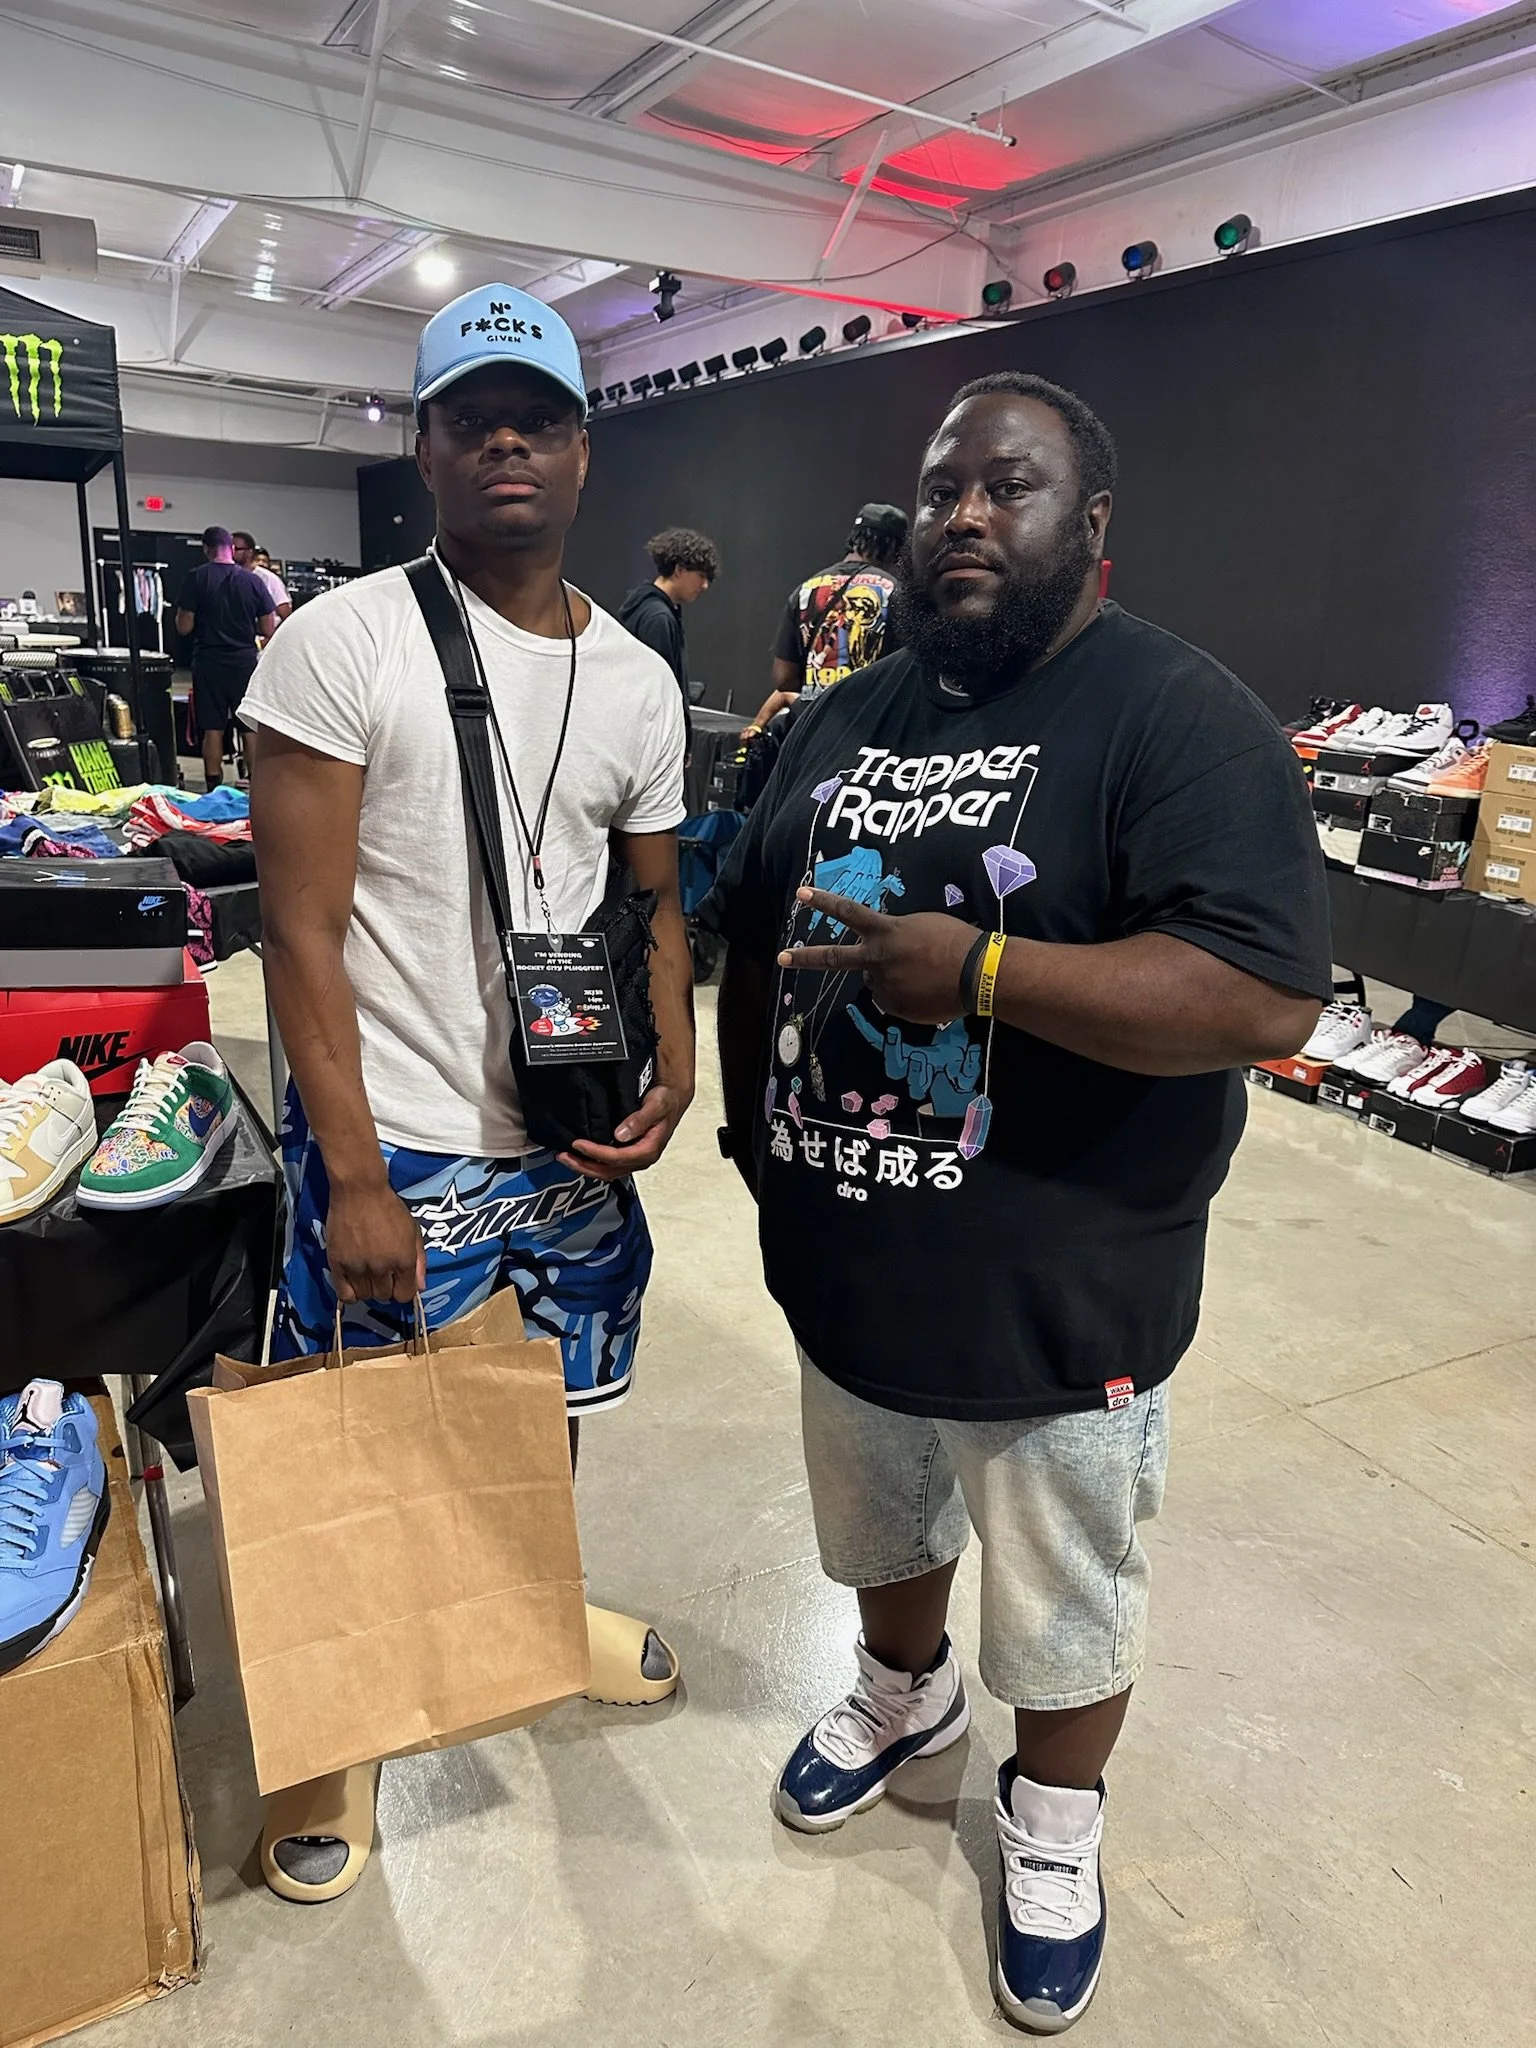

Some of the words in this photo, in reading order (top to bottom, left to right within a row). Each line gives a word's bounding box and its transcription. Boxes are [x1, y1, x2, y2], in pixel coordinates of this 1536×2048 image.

[486, 335, 521, 343] GIVEN
[68, 740, 114, 774] HANG
[850, 744, 1041, 796] Trapper
[82, 766, 122, 796] TIGHT!
[827, 785, 1012, 844] Rapper
[142, 895, 163, 905] NIKE
[57, 1030, 131, 1066] NIKE
[770, 1118, 963, 1190] 為せば成る
[836, 1181, 868, 1202] dro
[1110, 1385, 1130, 1394] WAKA
[1112, 1397, 1130, 1406] dro
